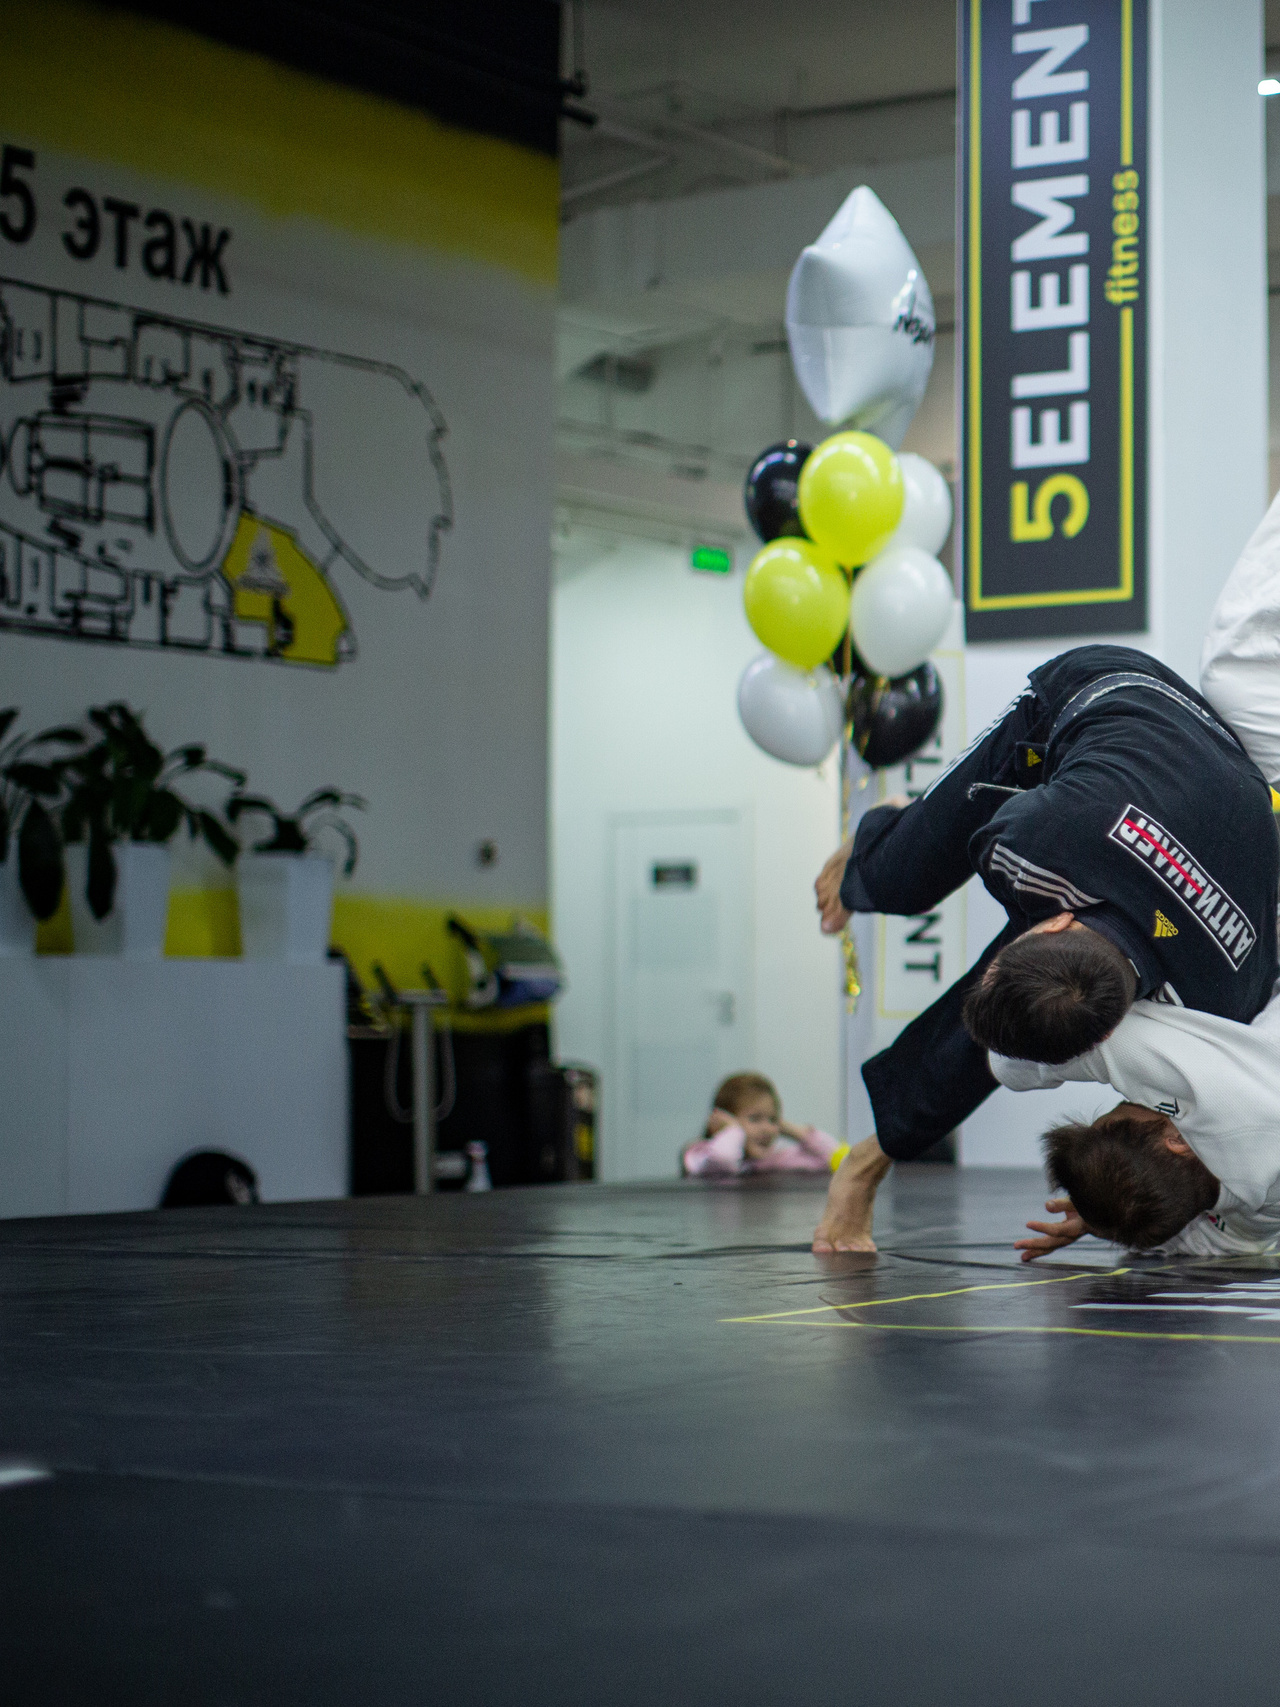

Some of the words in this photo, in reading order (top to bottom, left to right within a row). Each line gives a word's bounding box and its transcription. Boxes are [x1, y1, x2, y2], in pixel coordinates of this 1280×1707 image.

[0, 143, 36, 246] 5
[61, 187, 232, 295] этаж
[1011, 0, 1090, 543] 5ELEMEN
[1106, 168, 1140, 307] fitness
[1155, 909, 1179, 936] adidas
